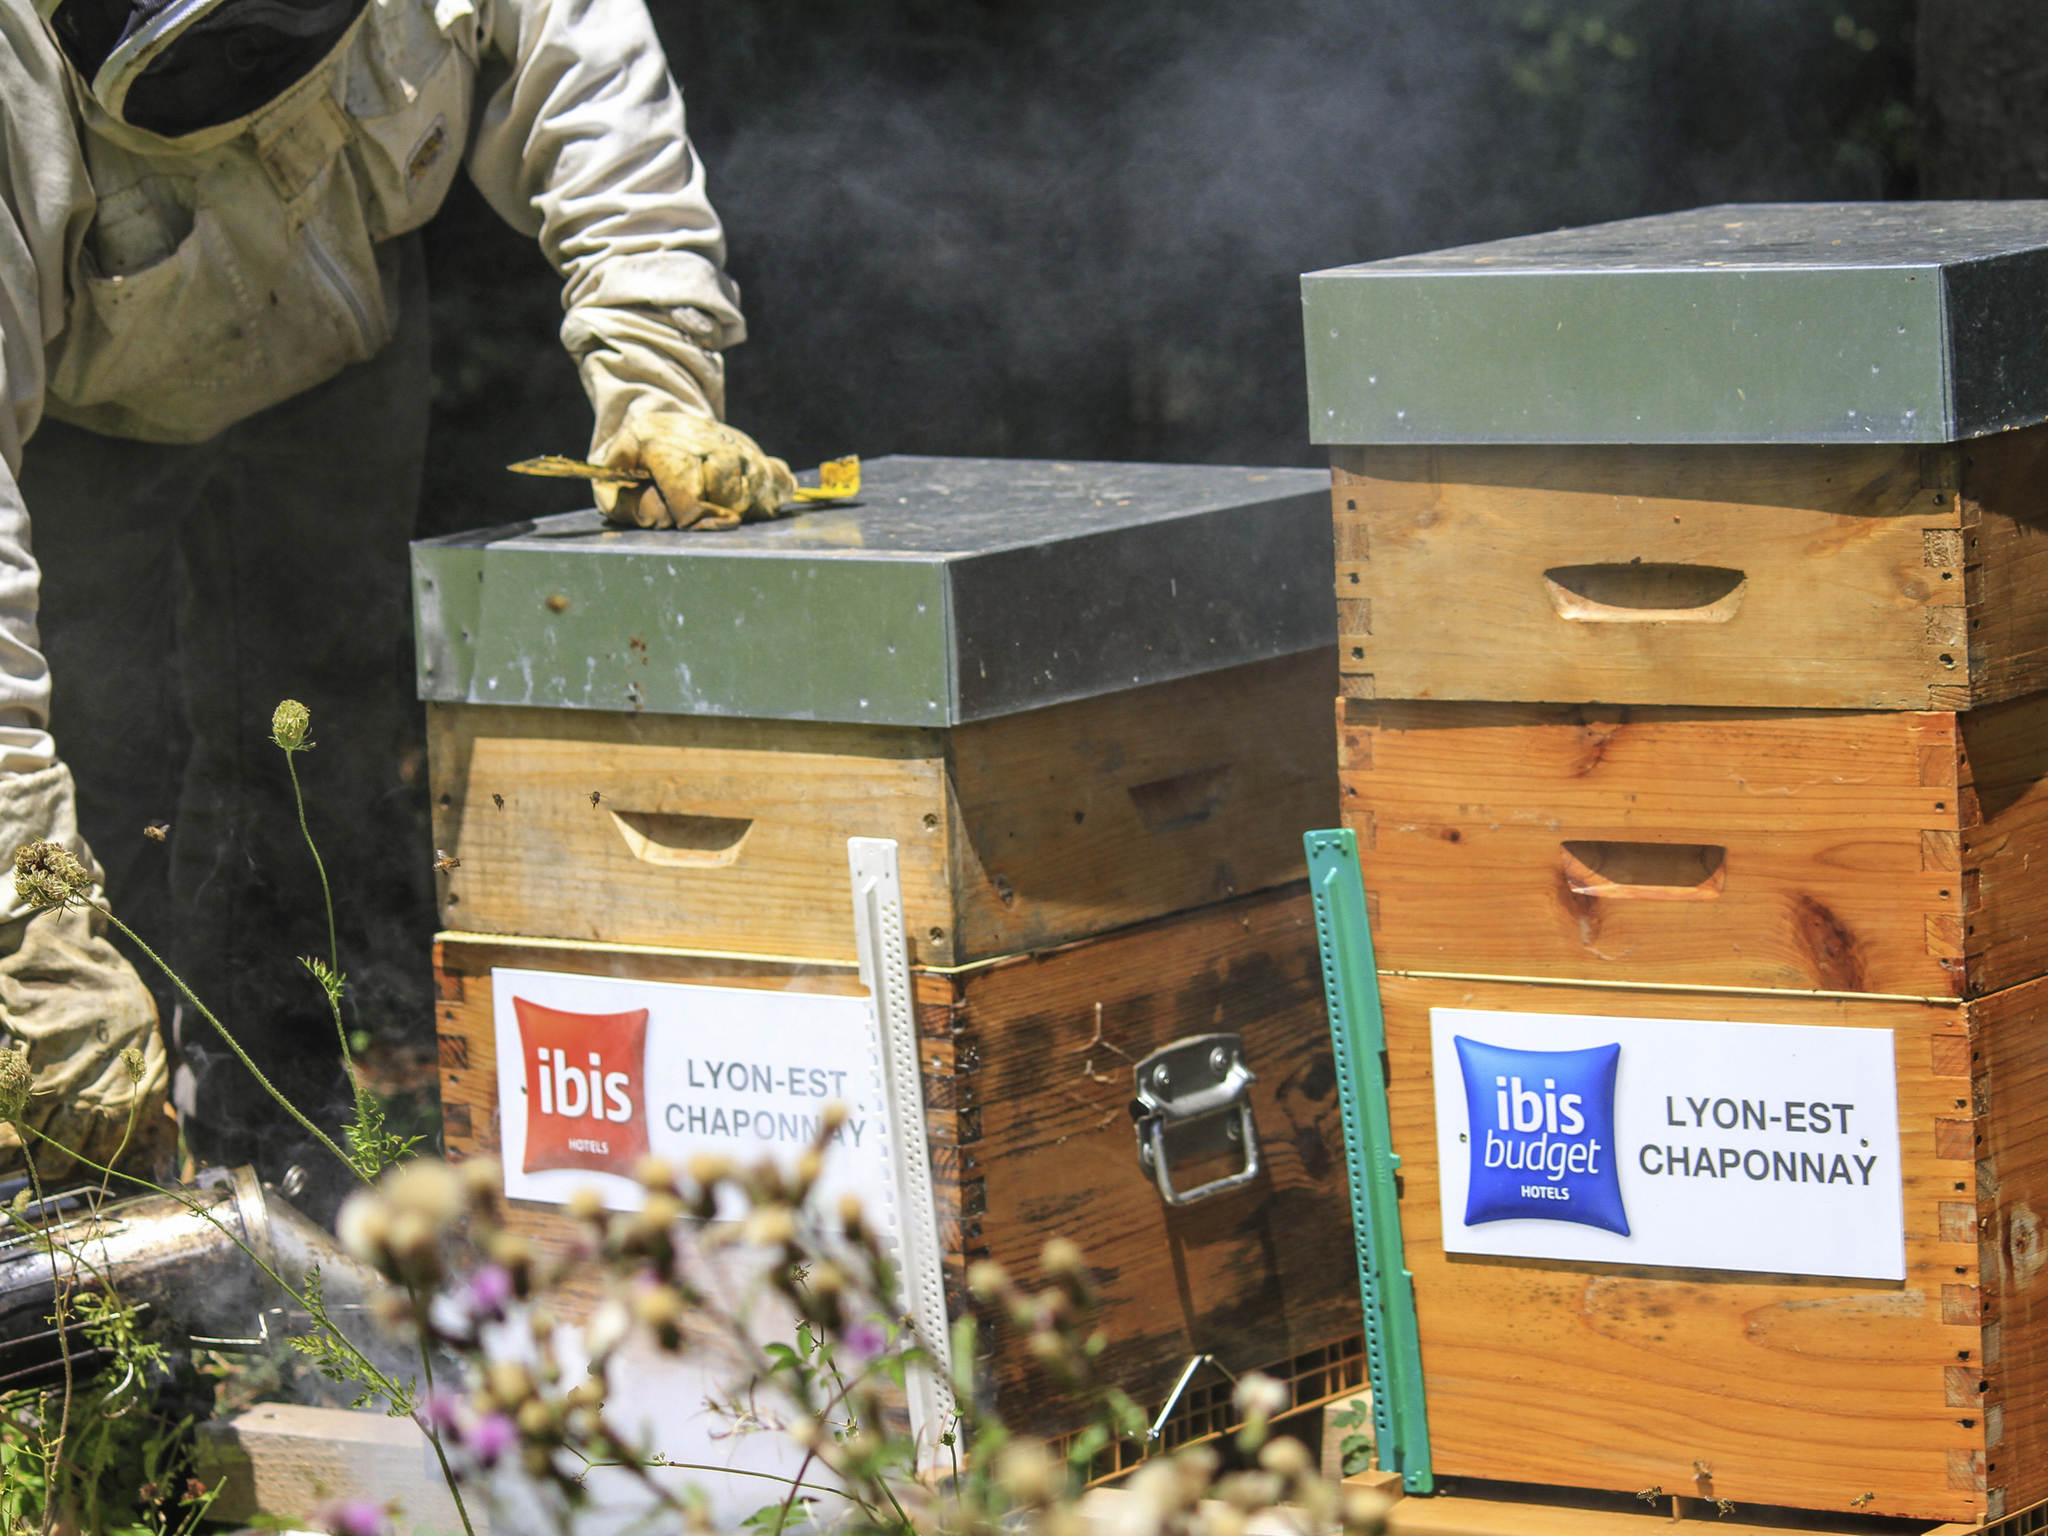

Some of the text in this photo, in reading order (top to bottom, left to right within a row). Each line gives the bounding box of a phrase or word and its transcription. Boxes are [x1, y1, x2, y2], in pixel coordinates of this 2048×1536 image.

[537, 1046, 633, 1123] ibis
[688, 1058, 848, 1099] LYON-EST
[1495, 1075, 1585, 1135] ibis
[1665, 1096, 1854, 1135] LYON-EST
[568, 1138, 609, 1155] HOTELS
[1484, 1128, 1601, 1181] budget
[1639, 1143, 1877, 1186] CHAPONNAY
[1521, 1184, 1570, 1201] HOTELS
